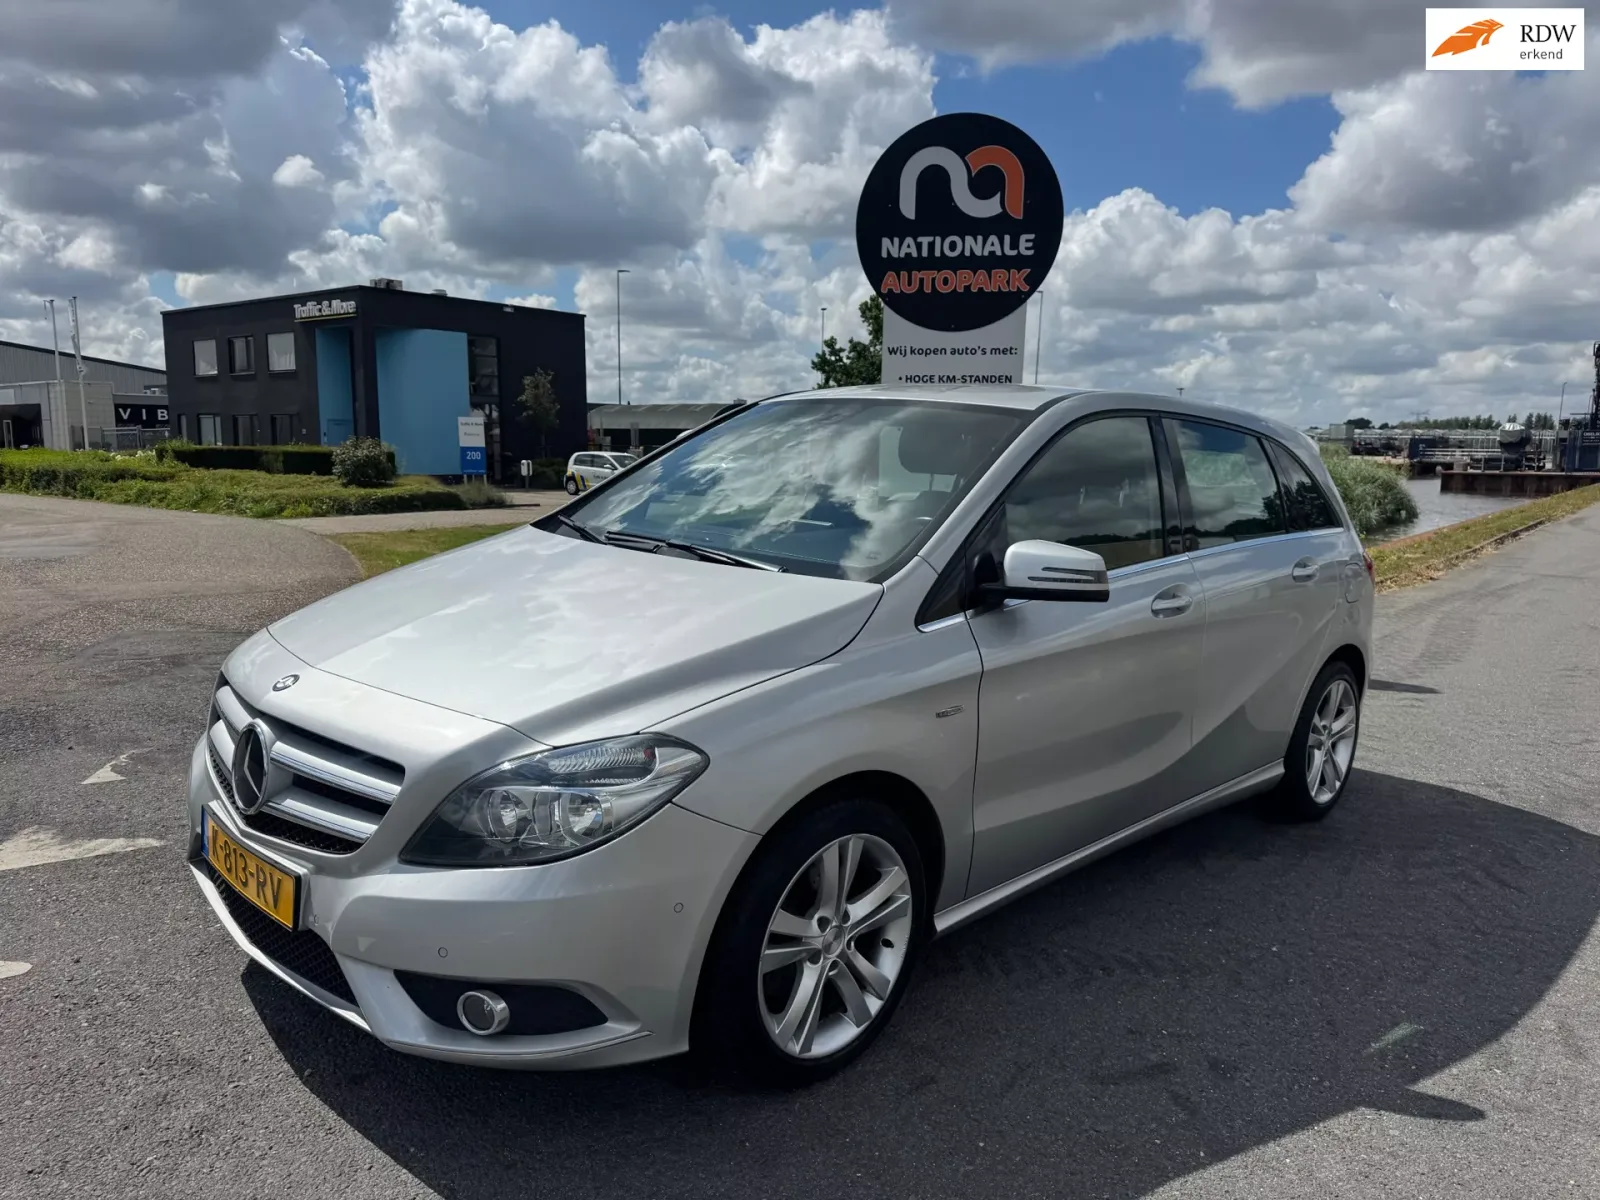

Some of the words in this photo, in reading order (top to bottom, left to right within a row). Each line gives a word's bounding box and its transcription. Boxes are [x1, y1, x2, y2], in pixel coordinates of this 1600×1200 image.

[881, 233, 1036, 259] NATIONALE
[880, 268, 1032, 294] AUTOPARK
[293, 301, 321, 318] Traffic
[321, 300, 331, 315] &
[331, 299, 357, 314] More
[887, 345, 907, 358] Wij
[910, 345, 947, 357] kopen
[950, 345, 987, 356] auto's
[990, 346, 1018, 356] met:
[905, 374, 935, 384] HOGE
[938, 374, 1013, 384] KM-STANDEN
[466, 451, 481, 460] 200
[212, 824, 282, 910] K-813-RV
